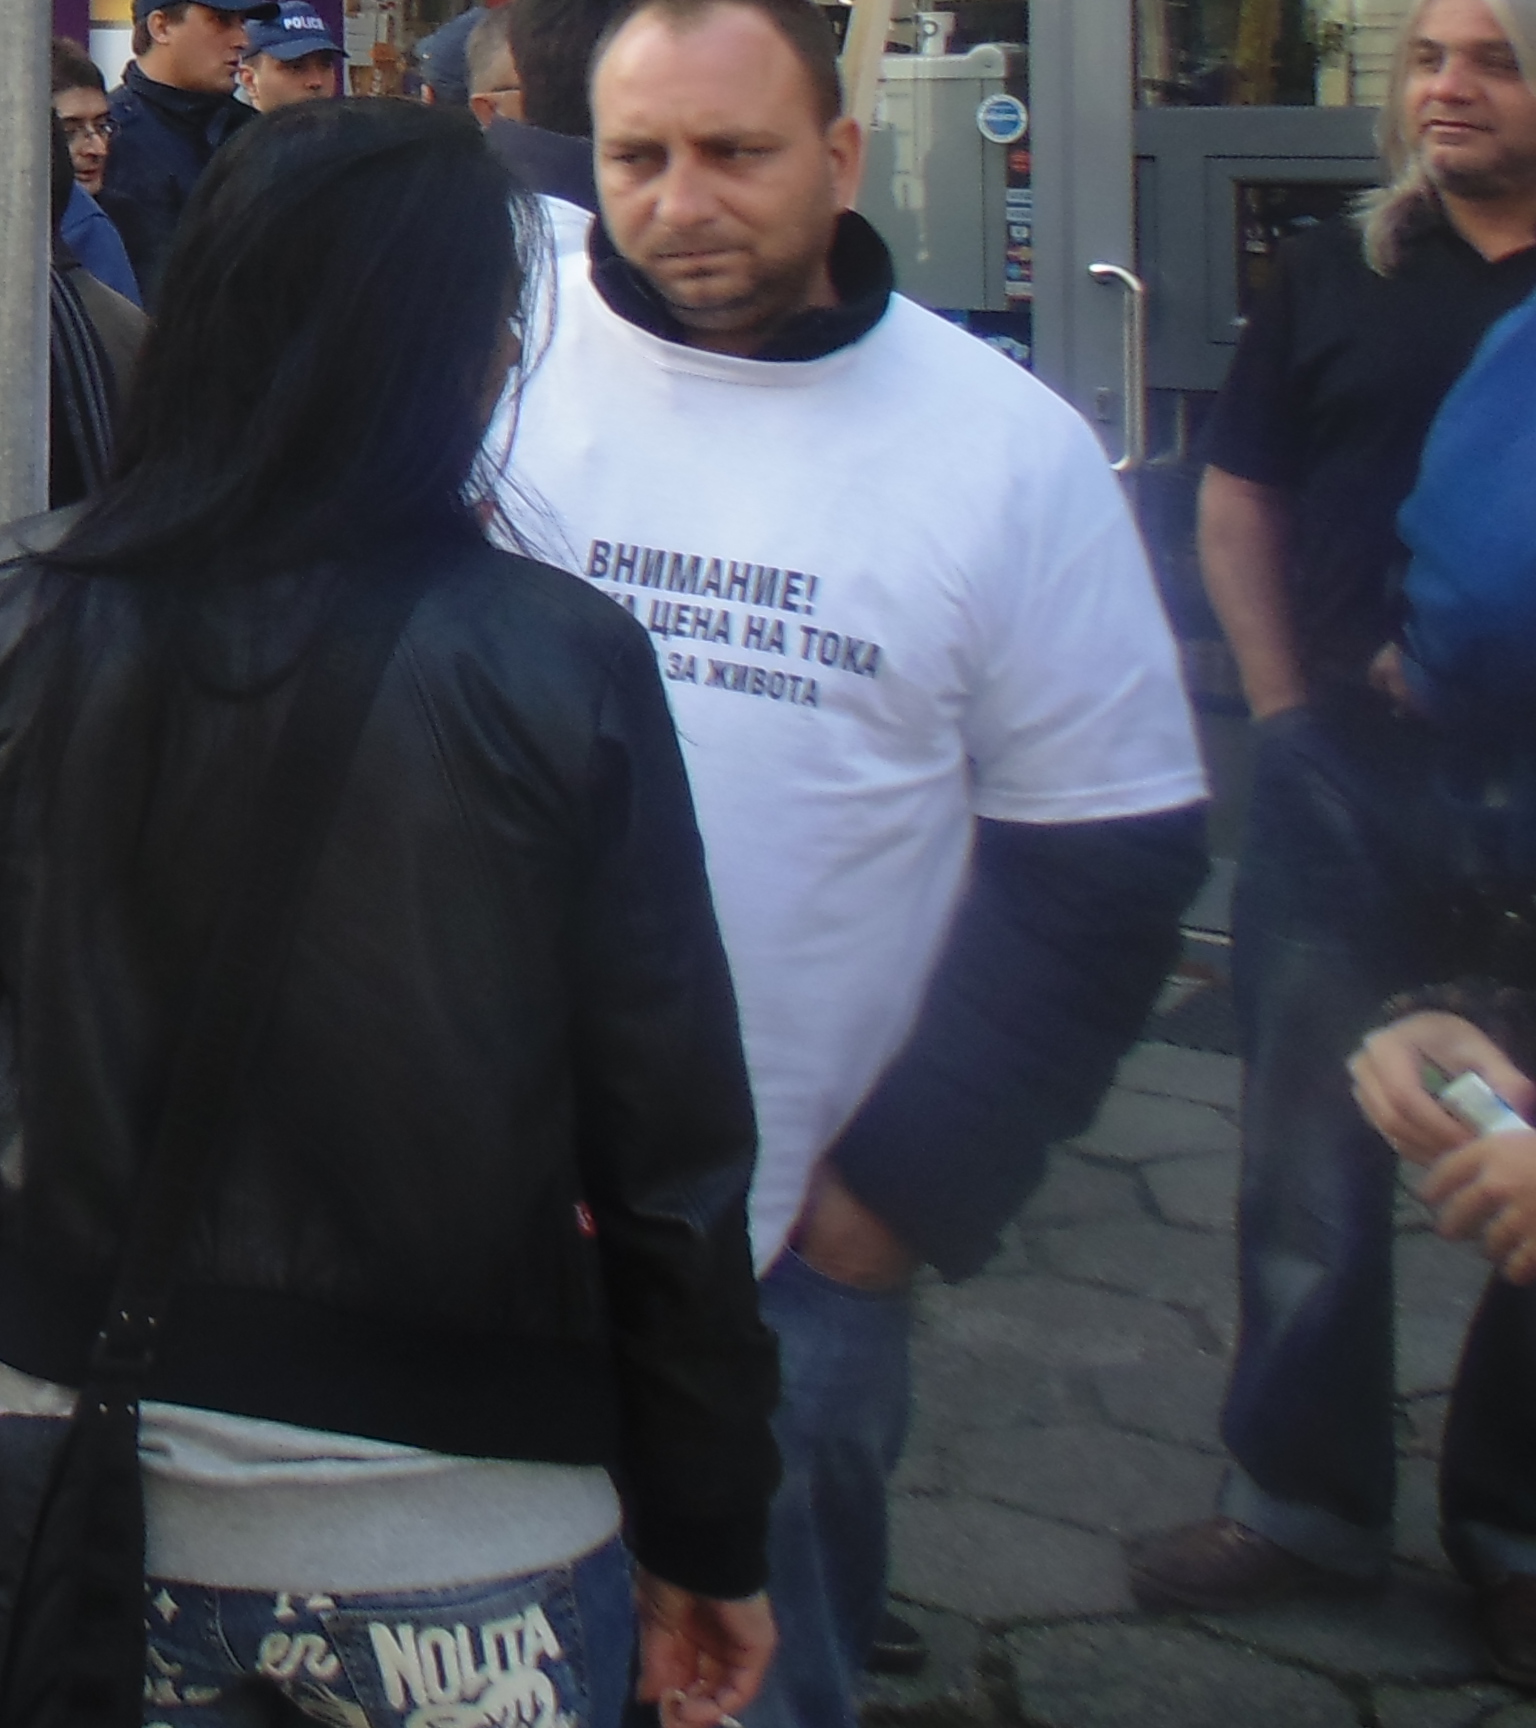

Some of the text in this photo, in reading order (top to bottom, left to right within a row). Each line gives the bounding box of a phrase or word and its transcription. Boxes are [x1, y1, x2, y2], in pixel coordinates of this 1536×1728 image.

[283, 16, 325, 32] POLICE
[587, 538, 819, 616] ВНИМАНИЕ!
[648, 598, 732, 645] ЦЕНА
[741, 614, 787, 657] НА
[799, 624, 883, 679] ТОКА
[703, 657, 820, 708] ЖИВОТА
